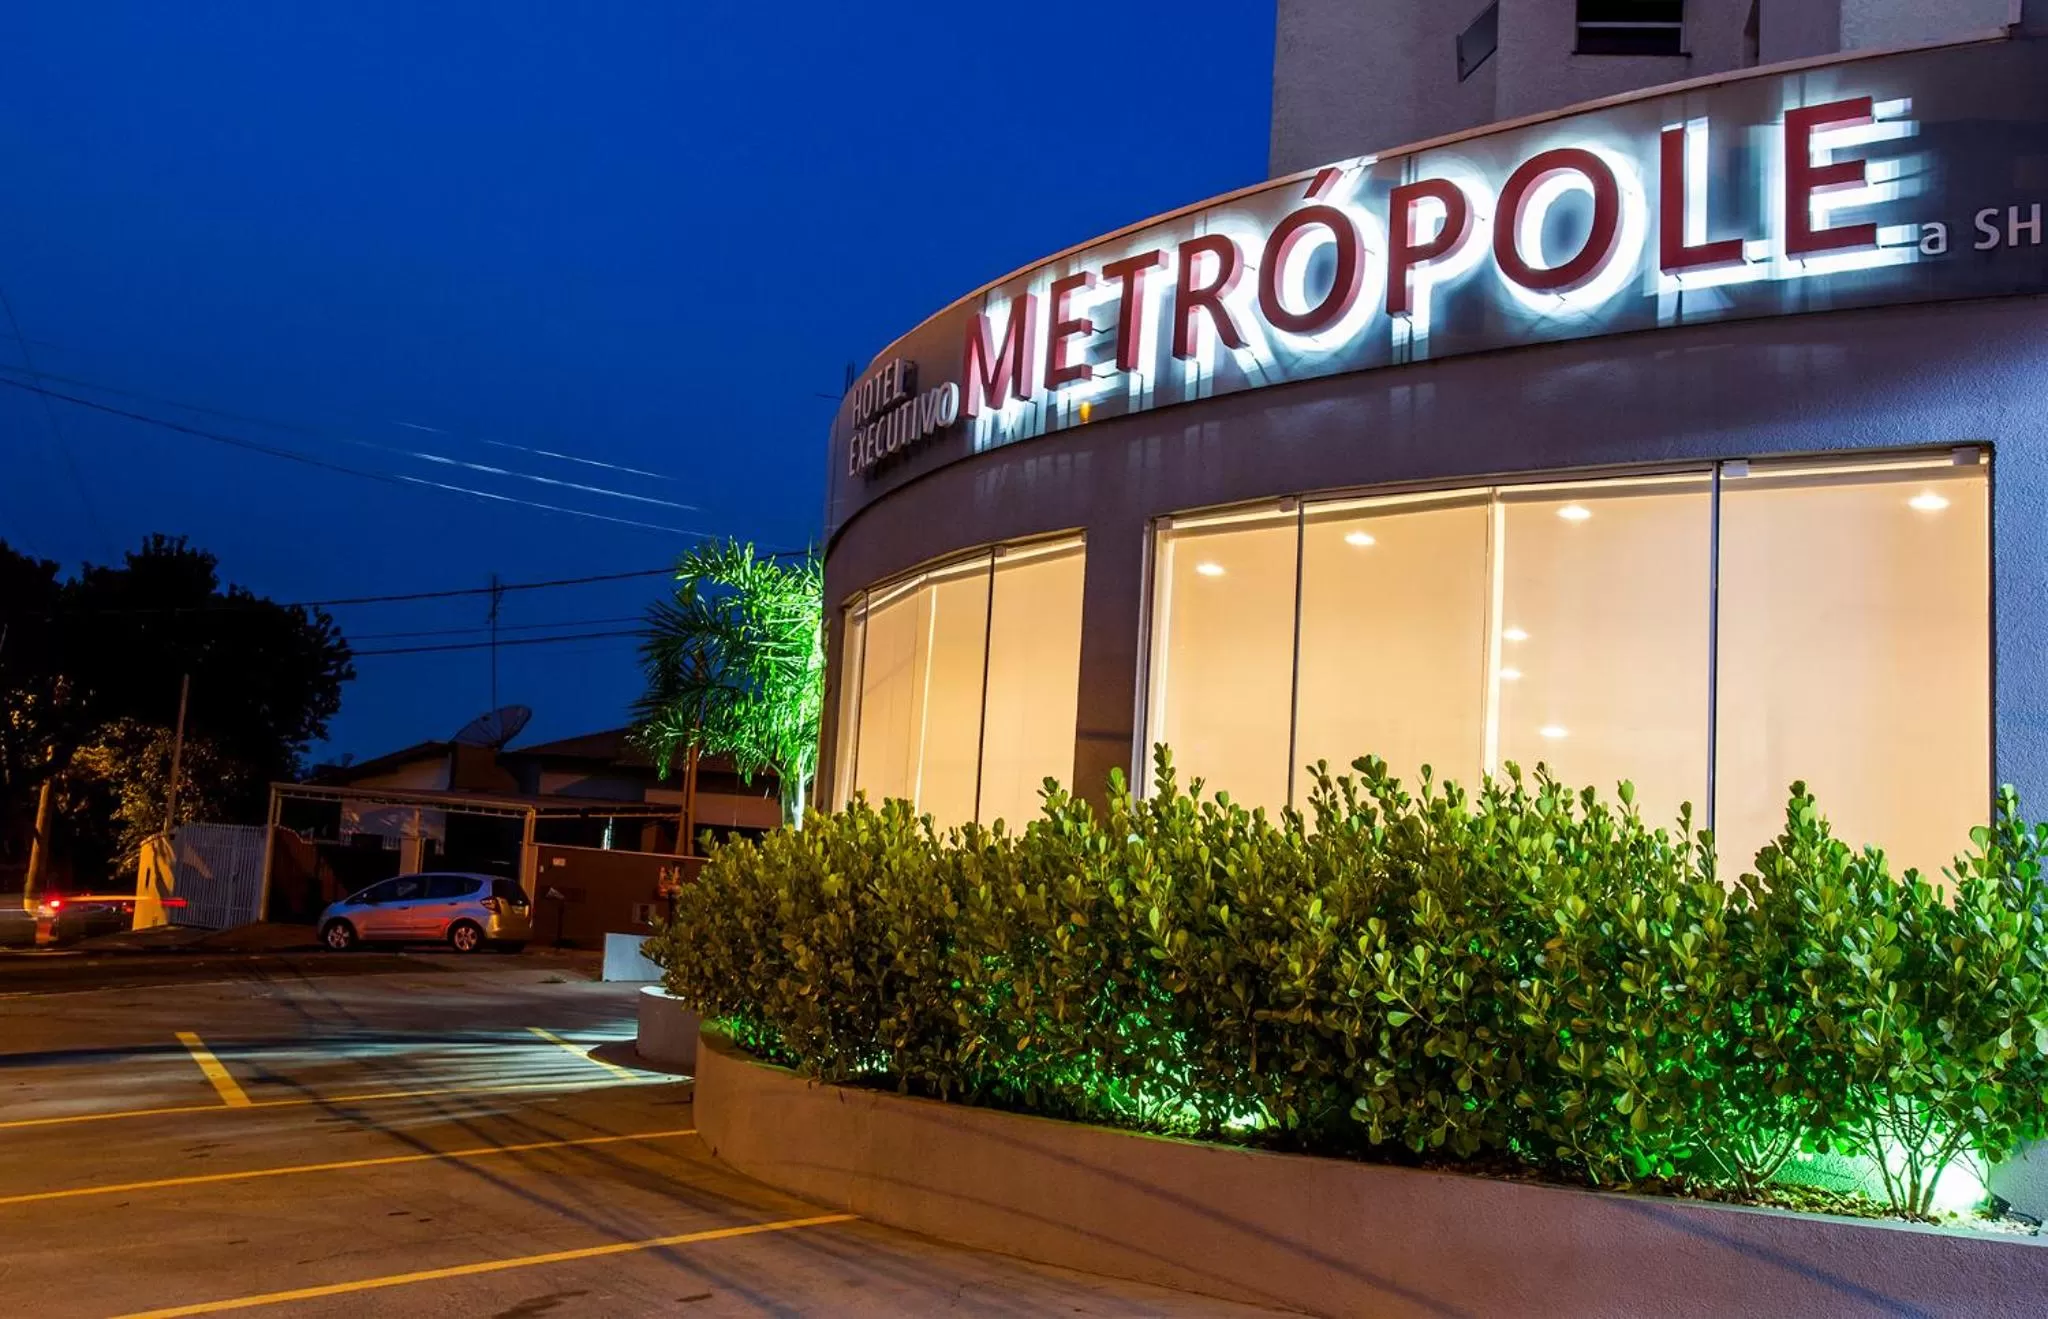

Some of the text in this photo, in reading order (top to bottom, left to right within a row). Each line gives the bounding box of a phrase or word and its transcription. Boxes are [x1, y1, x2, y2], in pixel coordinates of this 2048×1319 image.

[962, 96, 1878, 418] METRÓPOLE
[1919, 222, 1948, 255] a
[848, 382, 959, 476] EXECUTIVO
[852, 358, 907, 426] HOTEL
